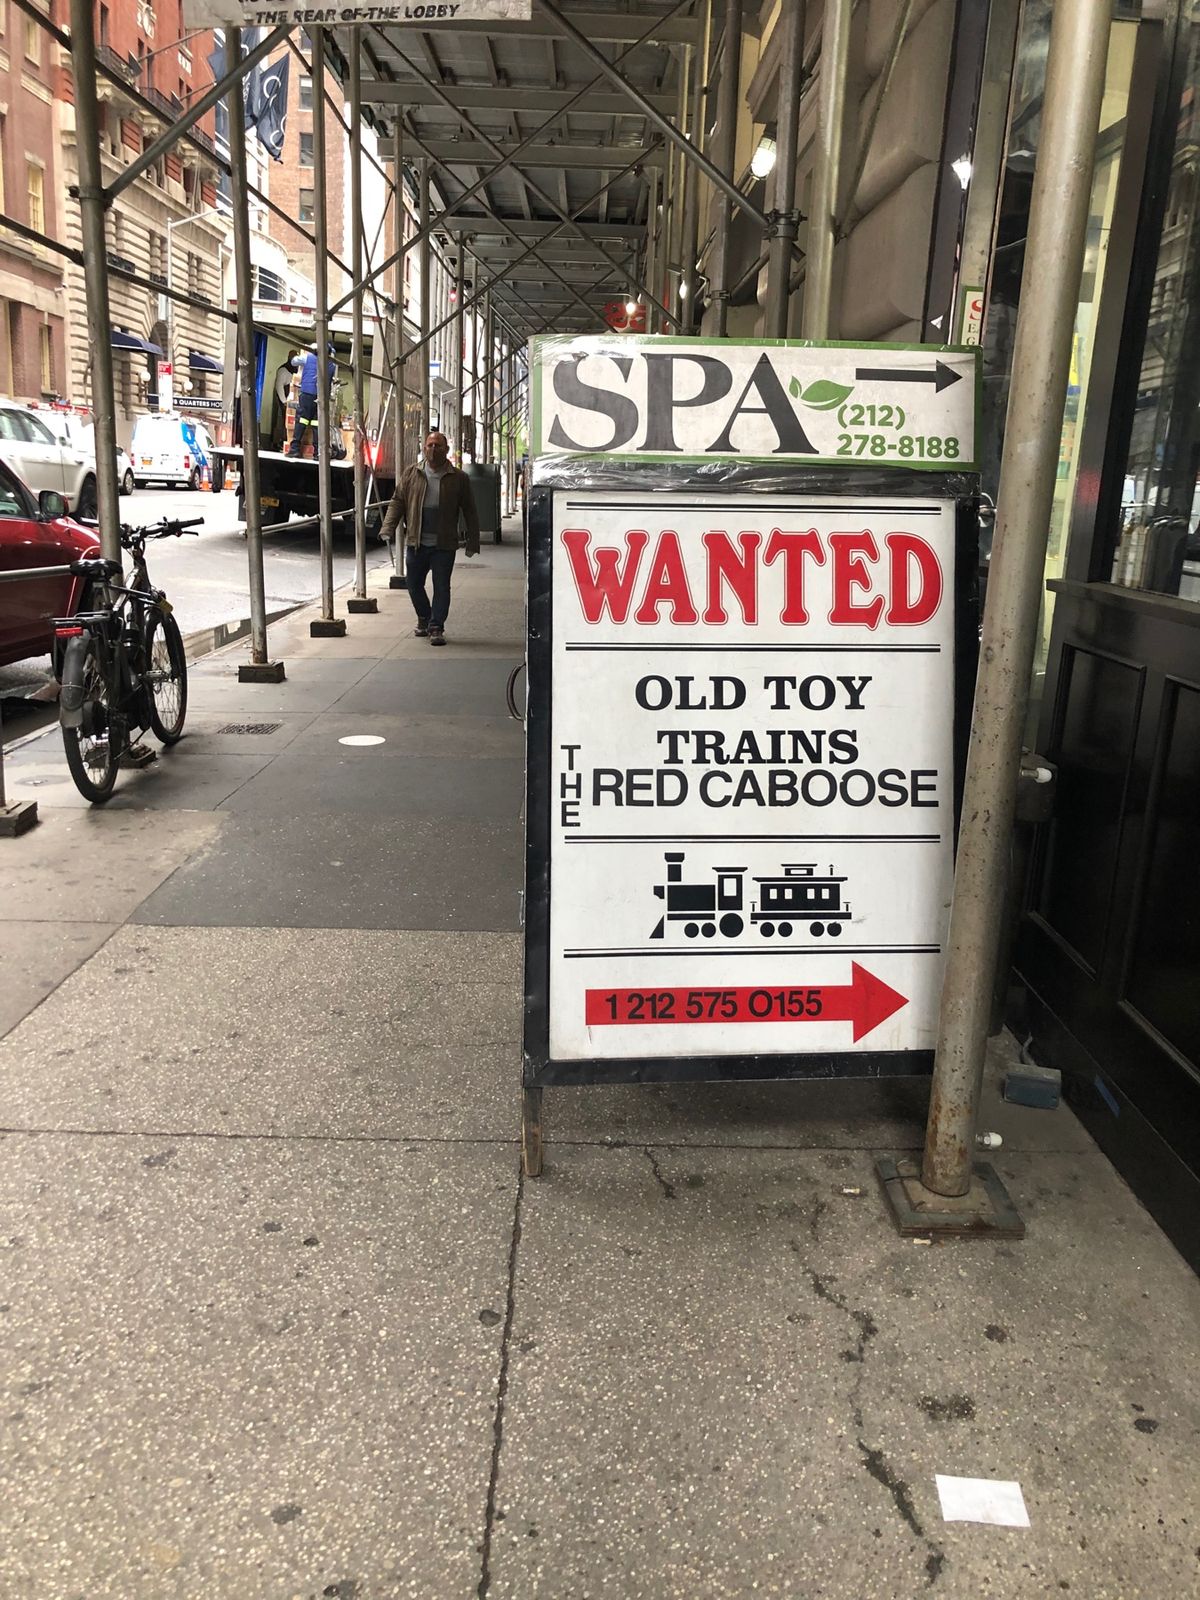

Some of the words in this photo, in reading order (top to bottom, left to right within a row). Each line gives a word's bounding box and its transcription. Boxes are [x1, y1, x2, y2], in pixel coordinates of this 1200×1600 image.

[256, 11, 288, 24] THE
[293, 9, 336, 22] REAR
[367, 7, 400, 20] THE
[404, 4, 460, 19] LOBBY
[178, 399, 210, 408] QUARTERS
[548, 352, 820, 456] SPA
[837, 403, 907, 430] (212)
[836, 434, 960, 459] 278-8188
[560, 527, 944, 631] WANTED
[635, 675, 747, 711] OLD
[763, 675, 873, 711] TOY
[657, 729, 860, 765] TRAINS
[560, 744, 582, 827] THE
[592, 768, 689, 807] RED
[699, 768, 940, 808] CABOOSE
[605, 993, 618, 1019] 1
[627, 992, 676, 1020] 212
[685, 990, 739, 1019] 575
